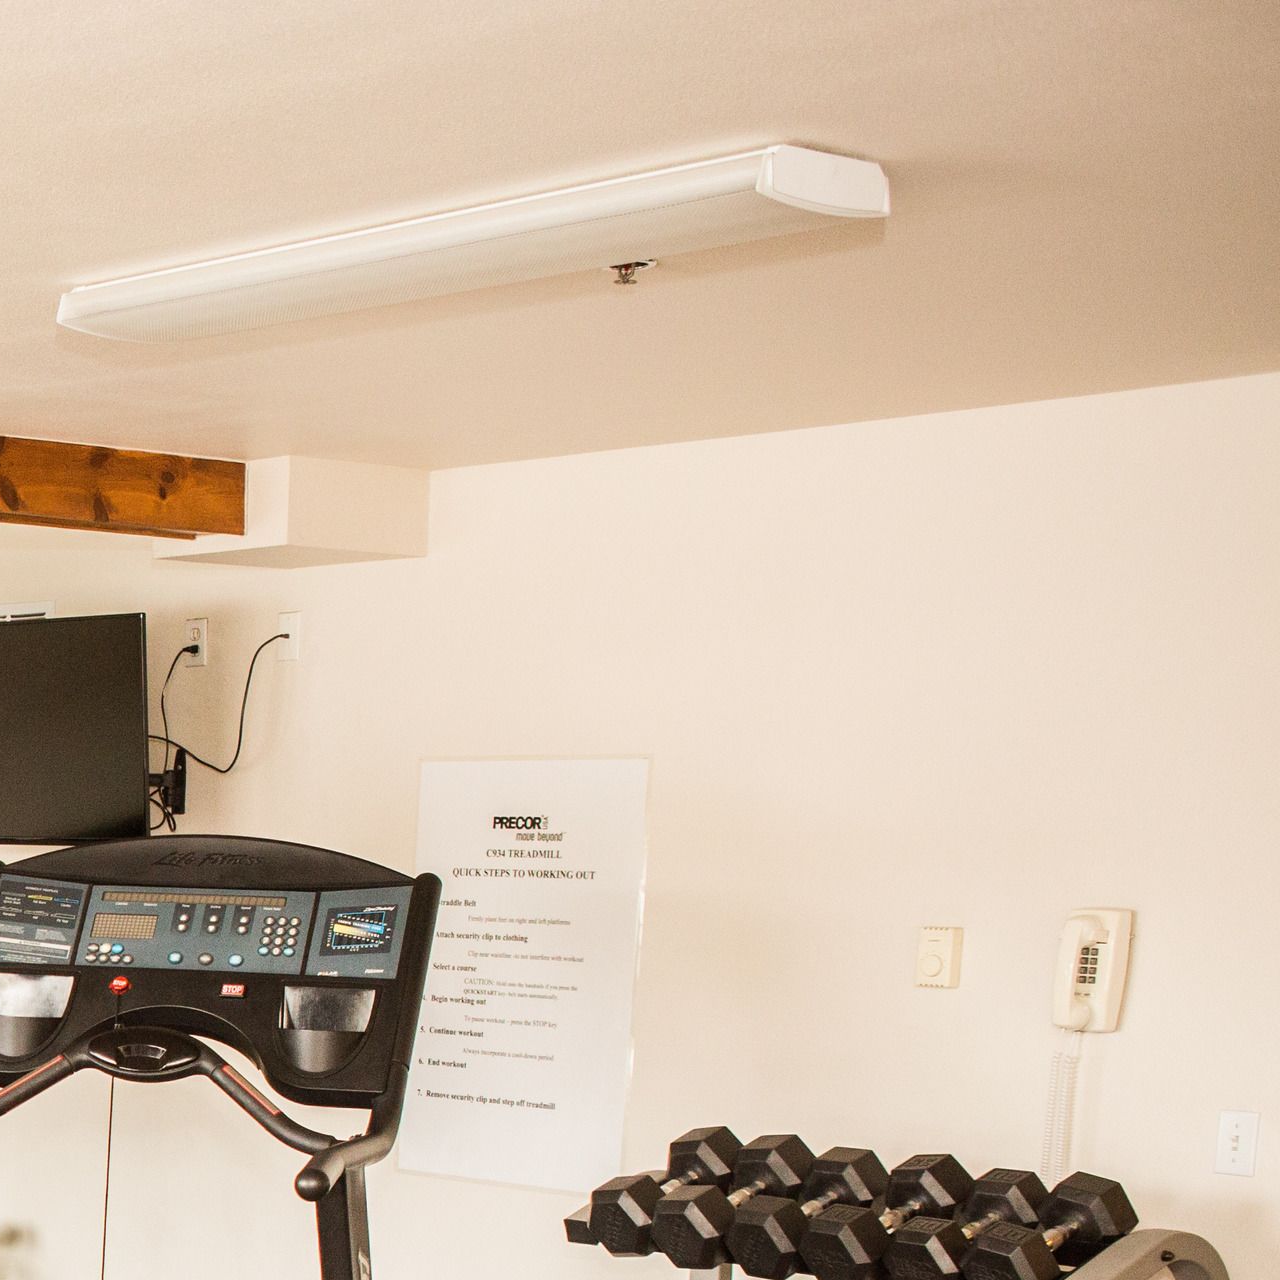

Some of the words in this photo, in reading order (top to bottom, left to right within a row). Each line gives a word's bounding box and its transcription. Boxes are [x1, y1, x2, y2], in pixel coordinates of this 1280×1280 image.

[493, 816, 541, 830] PRECOR
[537, 832, 563, 843] beyond
[486, 849, 506, 858] C934
[508, 850, 562, 859] TREADMILL
[452, 868, 482, 877] QUICK
[484, 868, 510, 878] STEPS
[514, 870, 525, 878] TO
[527, 870, 573, 879] WORKING
[576, 871, 596, 880] OUT
[456, 933, 480, 942] security
[482, 934, 493, 942] clip
[502, 934, 528, 943] clothing
[222, 985, 244, 994] STOP
[431, 995, 448, 1003] Begin
[450, 996, 474, 1005] working
[429, 1026, 456, 1036] Continue
[458, 1028, 484, 1038] workout
[428, 1058, 440, 1066] End
[441, 1060, 466, 1068] workout
[426, 1090, 449, 1099] Remove
[450, 1093, 474, 1102] security
[476, 1096, 488, 1104] clip
[502, 1098, 514, 1107] step
[526, 1100, 556, 1110] treadmill
